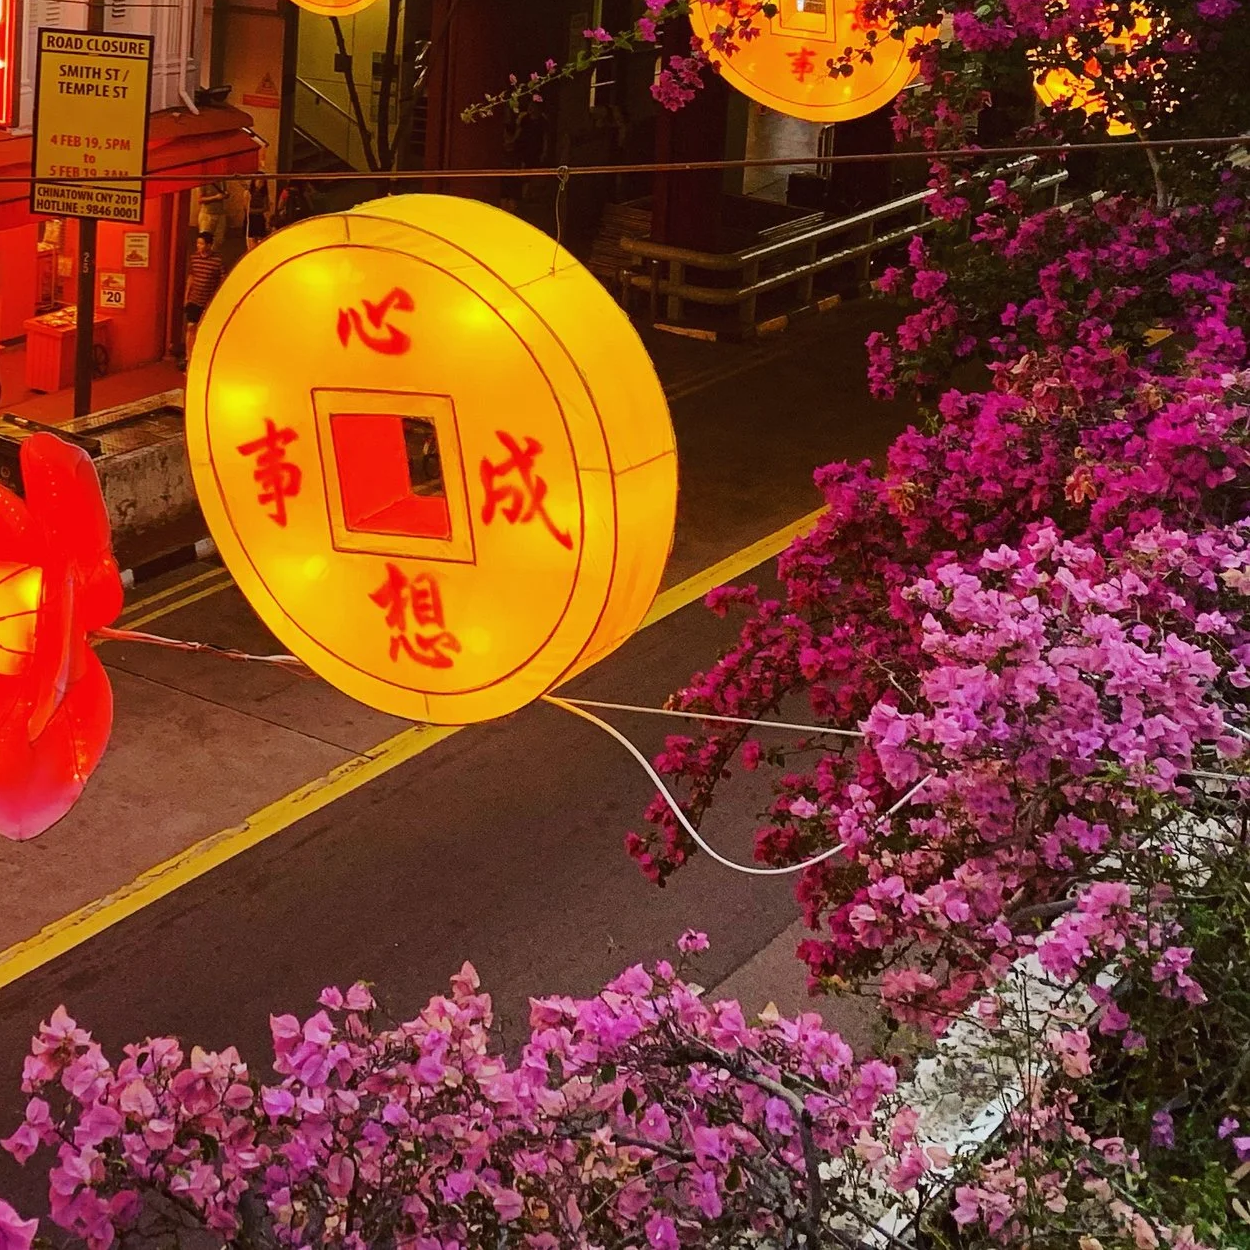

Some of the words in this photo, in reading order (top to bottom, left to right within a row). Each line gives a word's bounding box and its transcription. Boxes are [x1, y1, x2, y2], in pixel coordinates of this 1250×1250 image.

[46, 35, 84, 51] ROAD
[86, 38, 146, 55] CLOSURE
[59, 64, 101, 80] SMITH
[104, 68, 121, 81] ST
[58, 81, 111, 97] TEMPLE
[112, 86, 129, 99] ST
[50, 134, 58, 146] 4
[60, 134, 82, 148] FEB
[105, 138, 131, 151] 5PM
[83, 153, 96, 164] to
[49, 165, 56, 177] 5
[59, 165, 80, 178] FEB
[37, 186, 93, 202] CHINATOWN
[95, 192, 114, 204] CNY
[115, 194, 139, 207] 2019
[36, 198, 79, 214] HOTLINE
[86, 204, 112, 218] 9846
[113, 206, 138, 220] 0001
[336, 286, 415, 356] 心
[236, 417, 303, 528] 事
[479, 429, 574, 551] 成
[367, 561, 463, 670] 想
